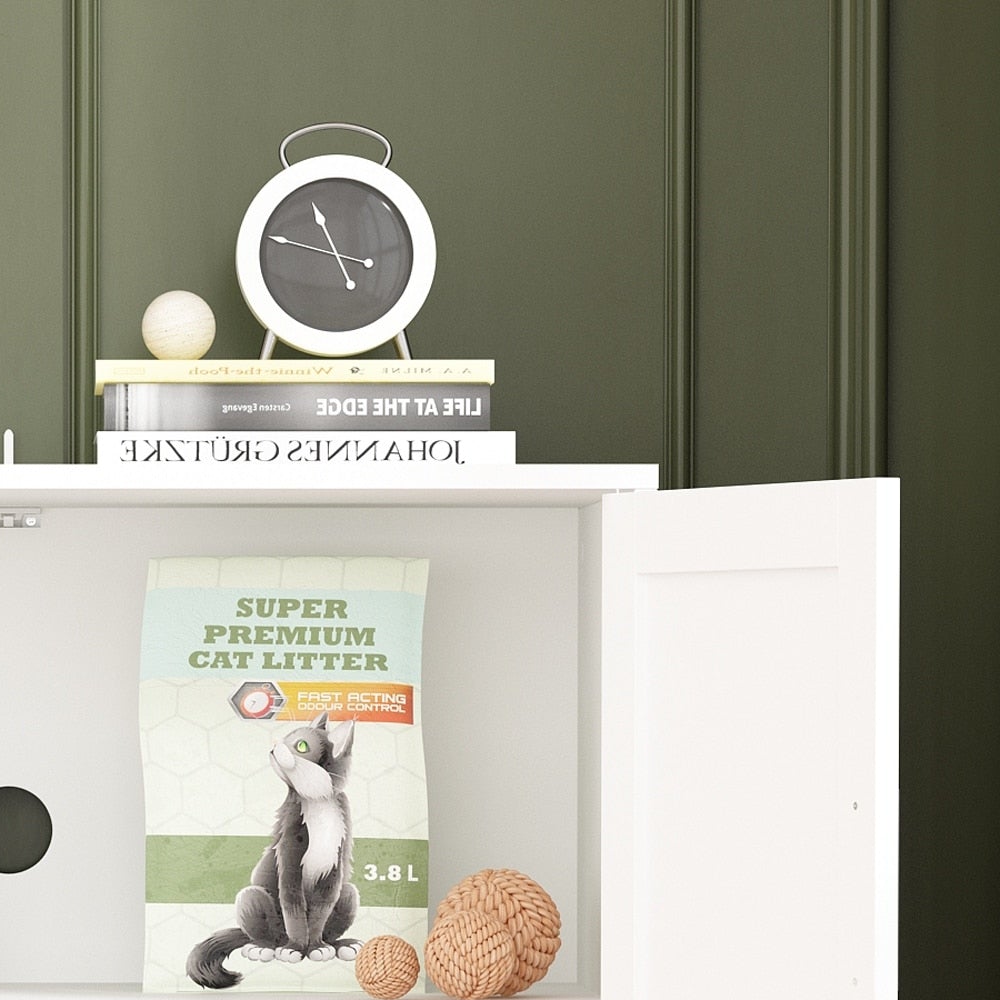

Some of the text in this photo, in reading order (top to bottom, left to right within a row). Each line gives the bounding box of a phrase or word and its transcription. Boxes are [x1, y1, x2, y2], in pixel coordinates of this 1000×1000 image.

[236, 597, 348, 619] SUPER
[203, 624, 376, 647] PREMIUM
[188, 650, 389, 671] CAT LITTER
[297, 691, 406, 705] FAST ACTING
[297, 702, 406, 713] ODOUR CONTROL
[364, 863, 419, 882] 3.8 L
